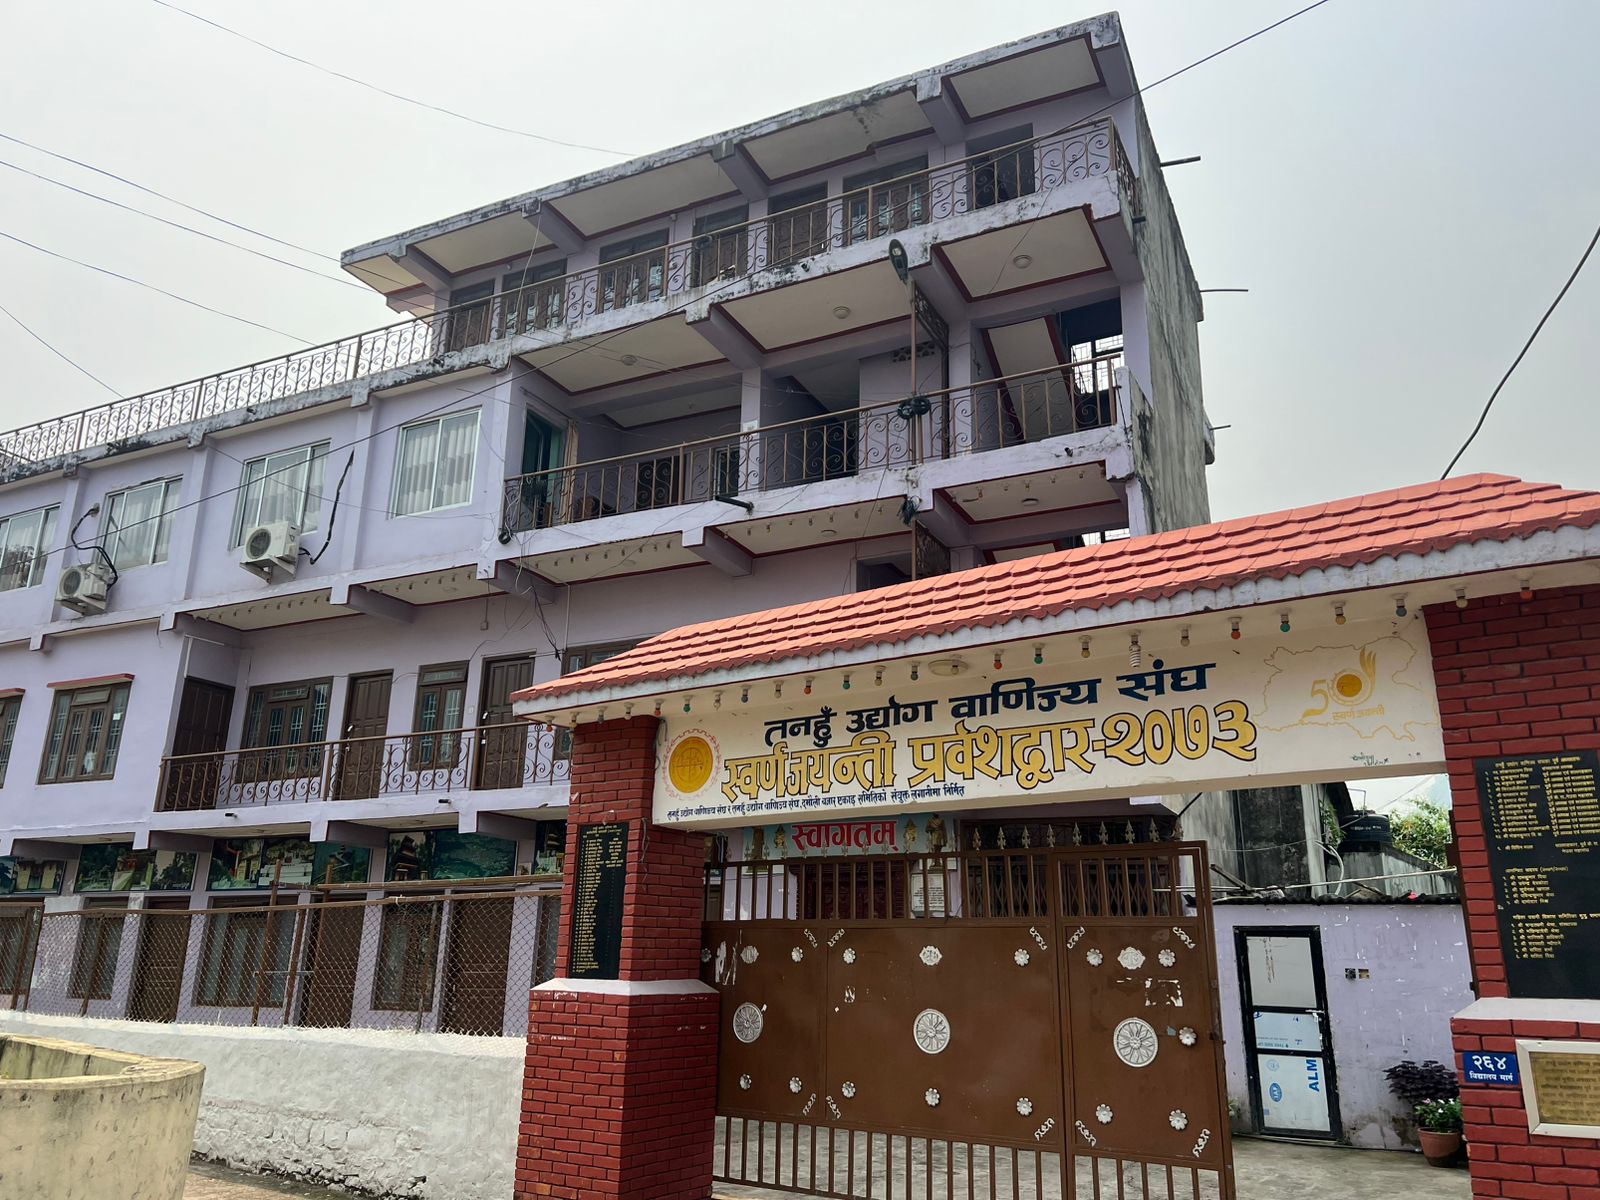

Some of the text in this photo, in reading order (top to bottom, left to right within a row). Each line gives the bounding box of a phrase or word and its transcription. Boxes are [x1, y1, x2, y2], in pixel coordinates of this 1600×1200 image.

[764, 659, 1217, 747] तनहुँ उद्योग वाणिज्य संघ
[792, 821, 899, 851] स्वागतम्
[1306, 1059, 1320, 1092] ALM
[1471, 1055, 1507, 1071] २६४
